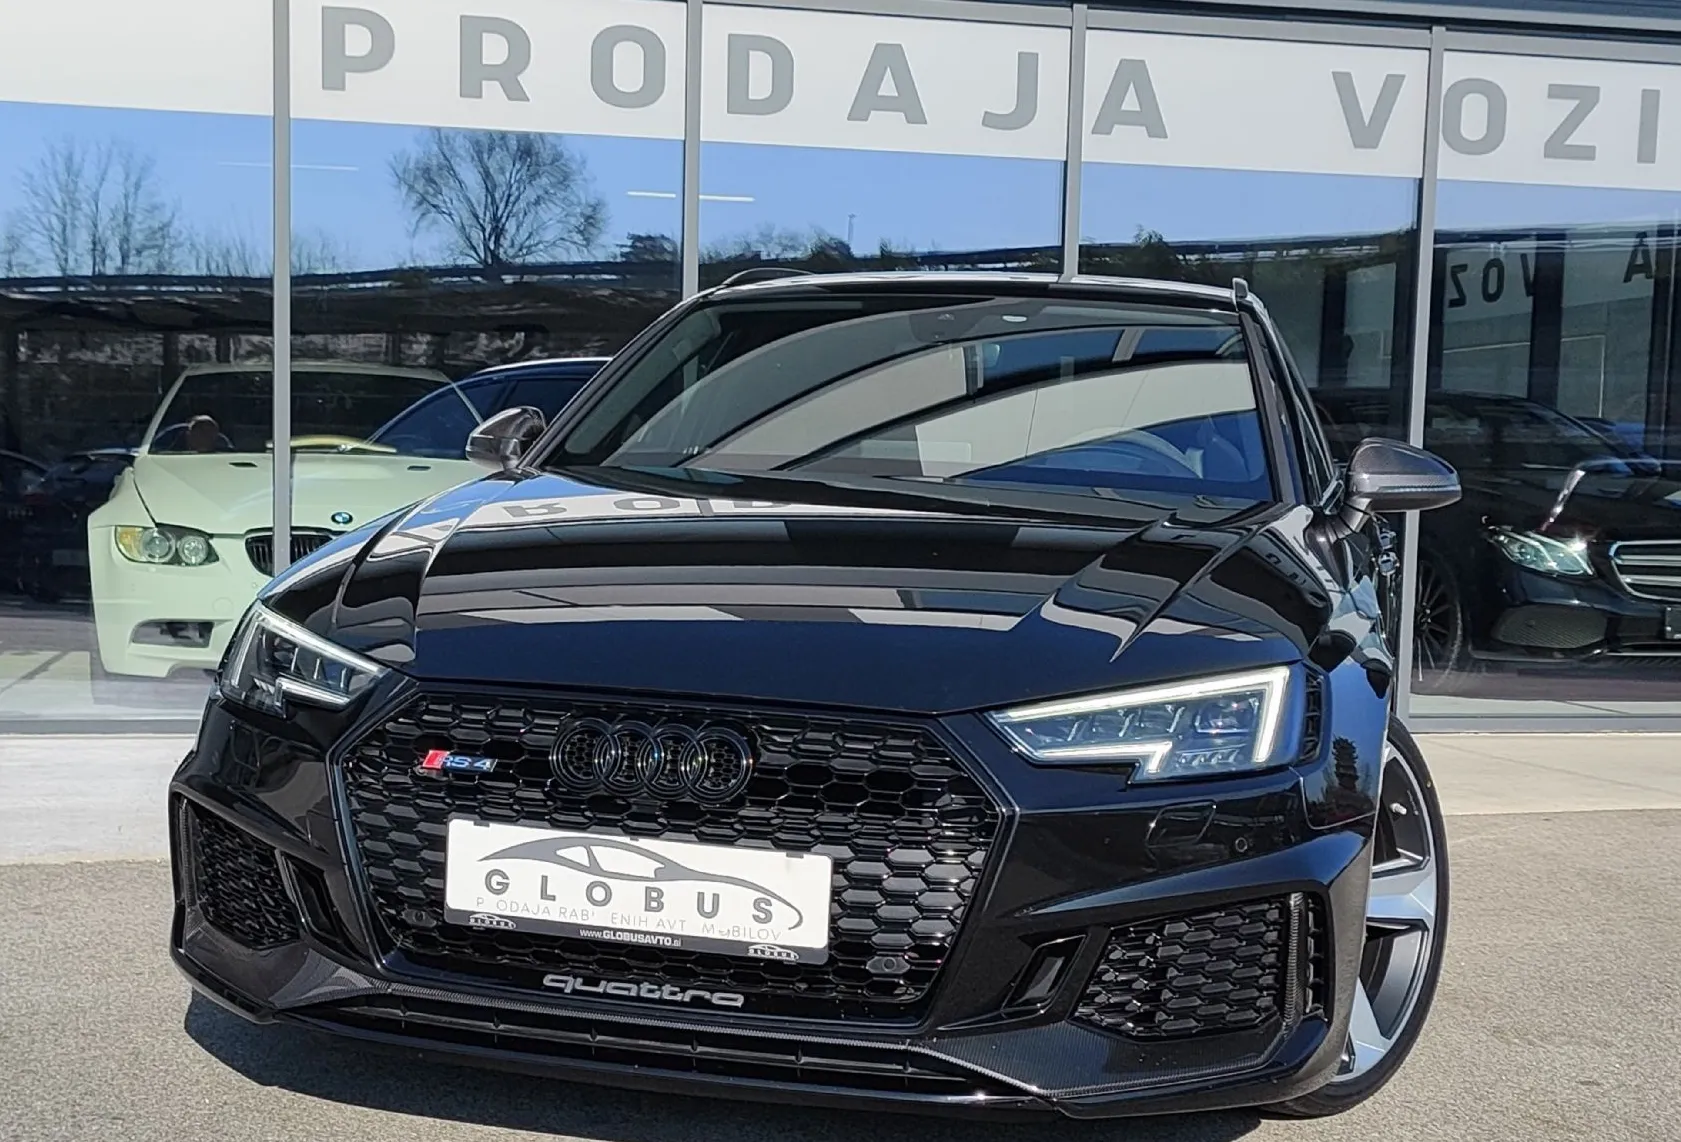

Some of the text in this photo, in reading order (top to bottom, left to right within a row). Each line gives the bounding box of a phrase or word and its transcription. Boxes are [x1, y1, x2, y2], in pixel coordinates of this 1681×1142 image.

[321, 6, 1662, 164] PRODAJA VOZI
[476, 897, 781, 941] PODAJA RABENIH AVTMBILOV
[484, 868, 774, 925] GLOBUS
[542, 973, 745, 1009] quattro
